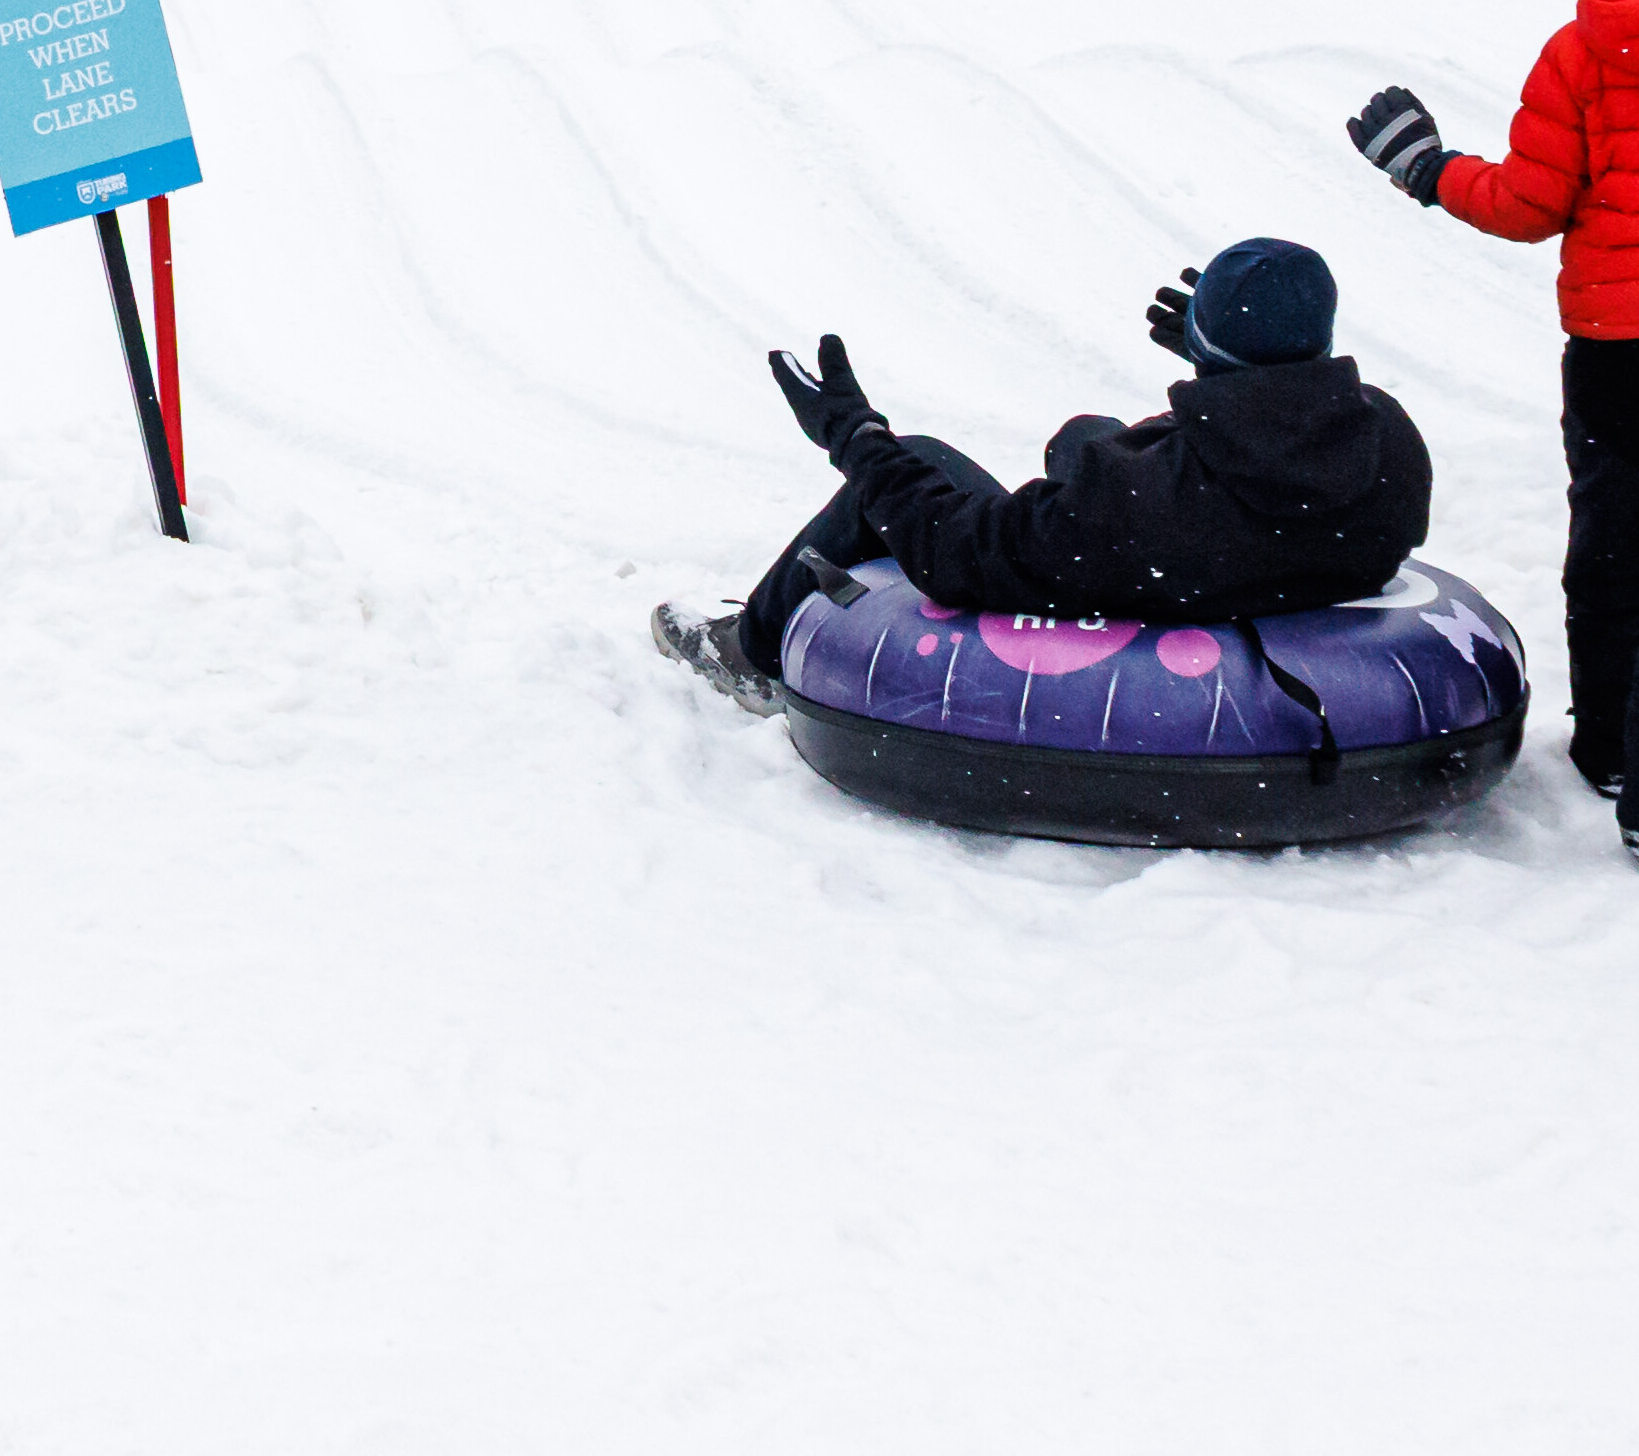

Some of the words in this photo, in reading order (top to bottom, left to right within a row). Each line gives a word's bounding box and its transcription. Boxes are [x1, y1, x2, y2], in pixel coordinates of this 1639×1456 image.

[28, 28, 110, 68] WHEN
[42, 61, 114, 100] LANE
[33, 88, 137, 135] CLEARS
